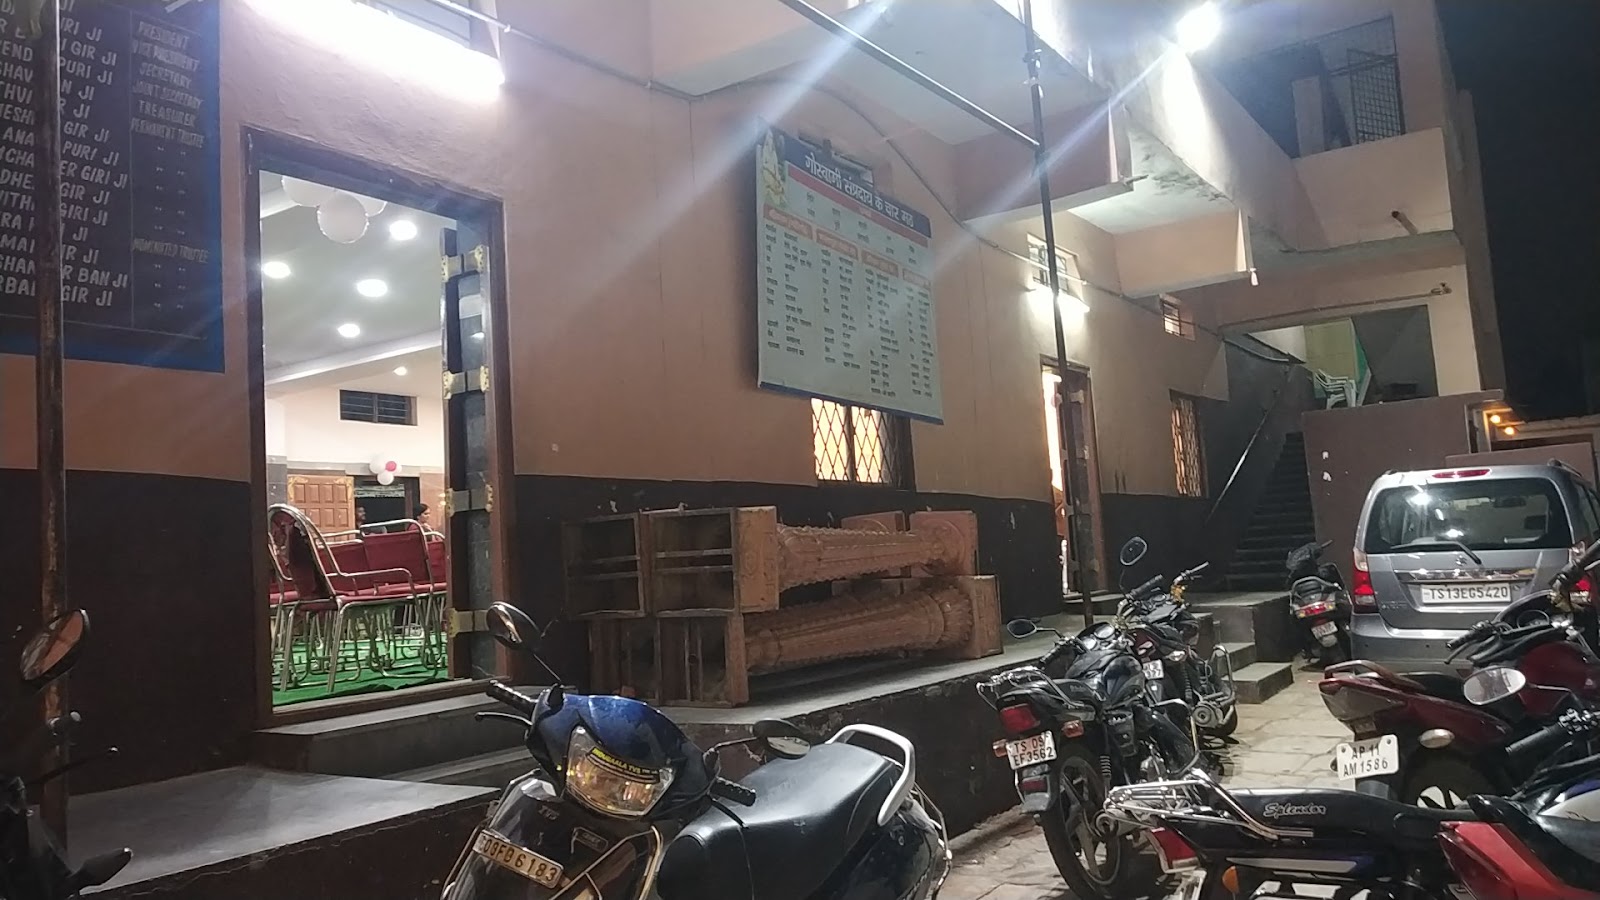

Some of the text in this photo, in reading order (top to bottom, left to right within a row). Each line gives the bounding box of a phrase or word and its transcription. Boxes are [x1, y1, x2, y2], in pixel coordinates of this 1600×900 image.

[86, 27, 103, 42] JI
[138, 20, 190, 49] PRESIDENT
[71, 41, 97, 60] GIR
[101, 52, 118, 66] JI
[97, 70, 114, 85] JI
[78, 85, 95, 101] JI
[73, 103, 90, 119] JI
[139, 99, 196, 127] TREASURER
[64, 121, 89, 138] GIR
[94, 128, 110, 143] JI
[64, 140, 98, 161] PURI
[103, 151, 119, 166] JI
[81, 164, 111, 185] GIRI
[114, 173, 128, 188] JI
[805, 151, 843, 190] गोस्वामी
[884, 200, 900, 220] चार
[60, 182, 86, 201] GIR
[93, 190, 110, 205] JI
[60, 202, 89, 221] GIRI
[93, 210, 109, 226] JI
[73, 227, 88, 241] JI
[83, 249, 99, 264] JI
[78, 269, 111, 286] BAN
[112, 273, 128, 288] JI
[62, 285, 89, 304] GIR
[96, 290, 112, 306] JI
[1430, 586, 1508, 600] TS13EG5420
[1013, 746, 1054, 767] EF3562
[1014, 741, 1027, 754] TS
[1352, 742, 1380, 760] AP 11
[1343, 757, 1388, 778] AM 1586
[1262, 802, 1327, 820] Splendor
